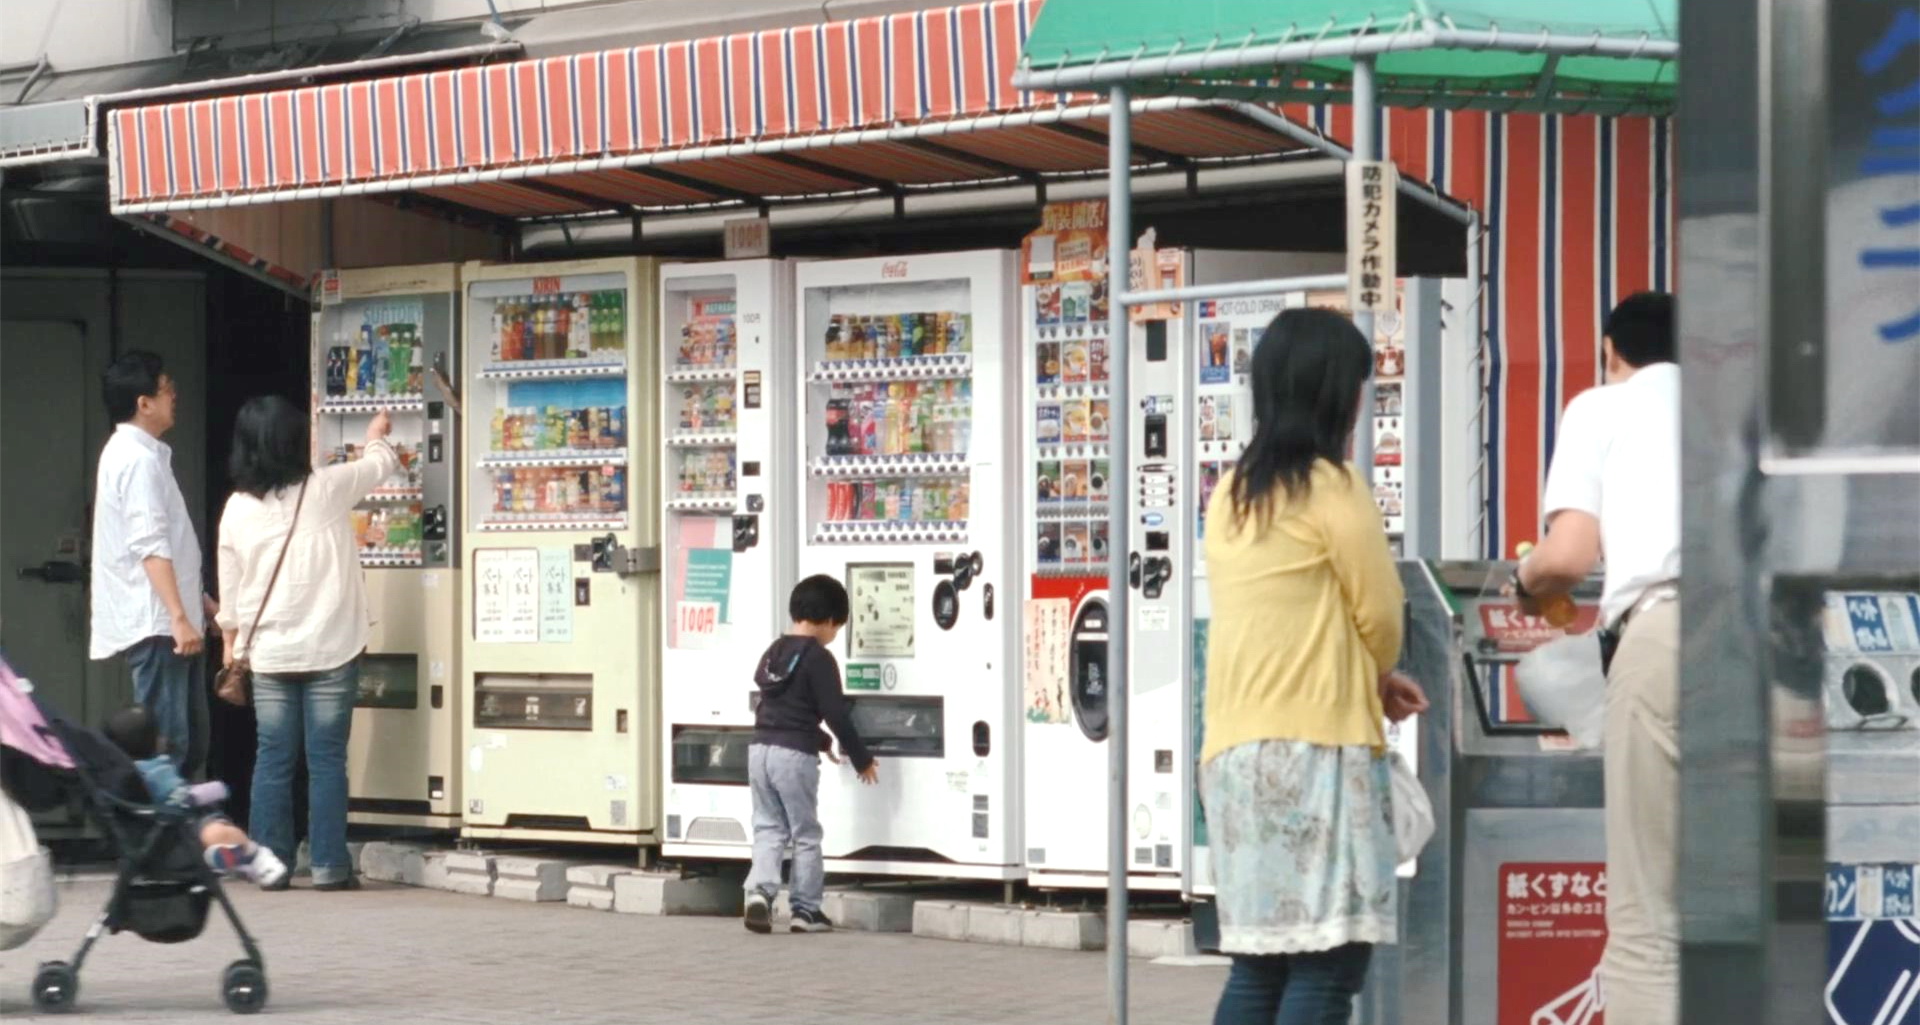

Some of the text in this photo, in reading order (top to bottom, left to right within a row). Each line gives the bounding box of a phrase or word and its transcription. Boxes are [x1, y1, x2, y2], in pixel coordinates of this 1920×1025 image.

[1360, 165, 1383, 307] 防犯カメラ作動中
[533, 276, 561, 294] KIRIN
[681, 605, 715, 633] 100円
